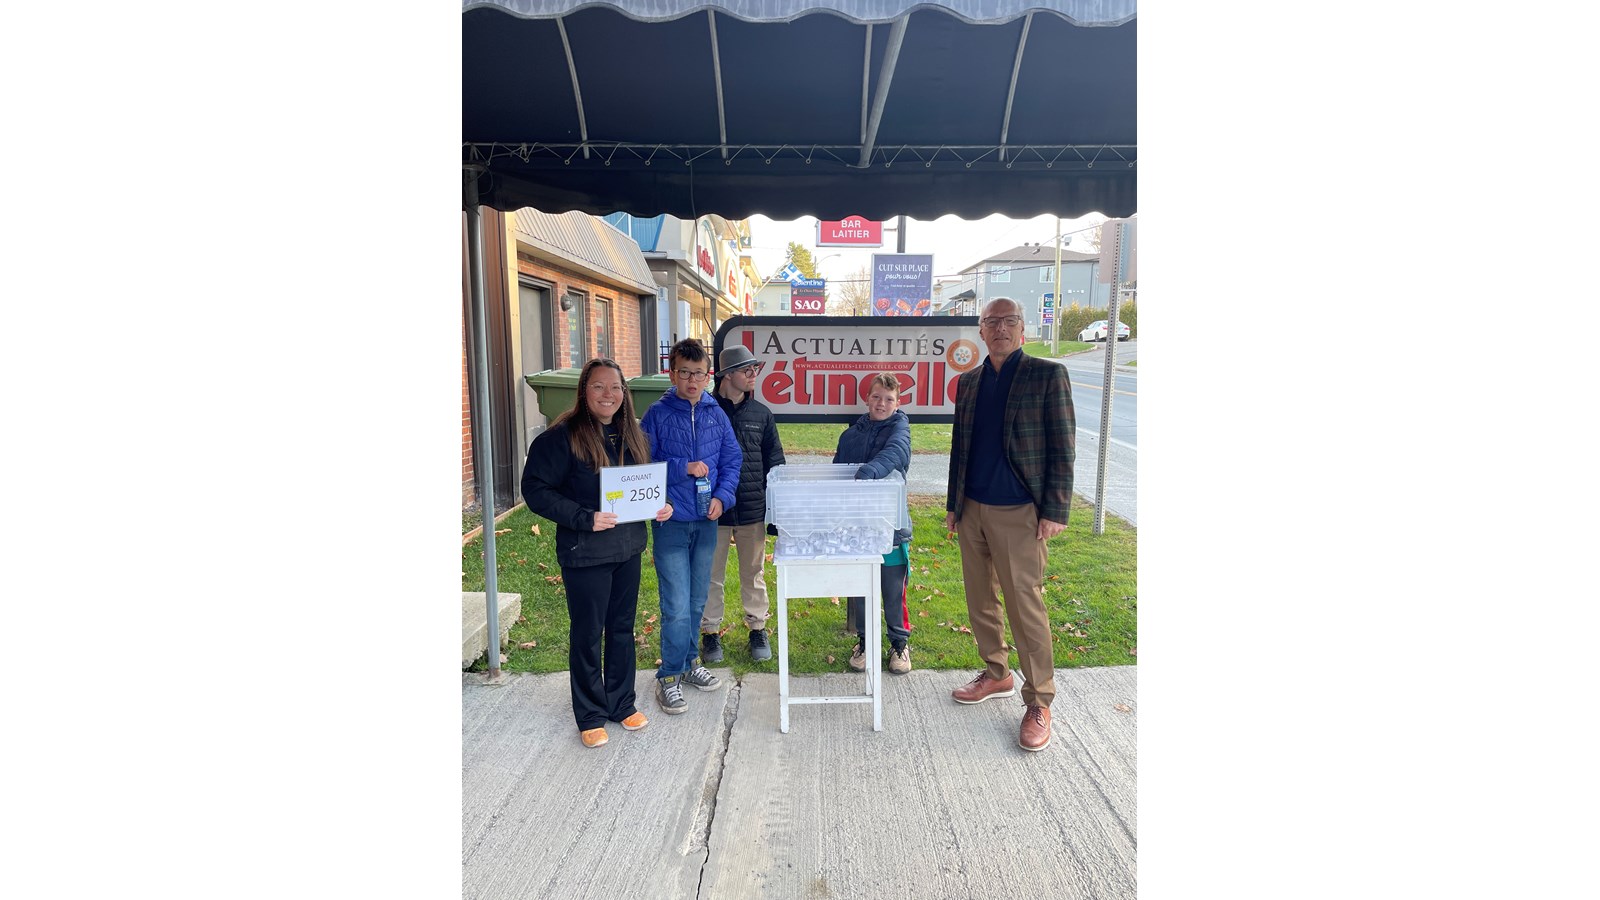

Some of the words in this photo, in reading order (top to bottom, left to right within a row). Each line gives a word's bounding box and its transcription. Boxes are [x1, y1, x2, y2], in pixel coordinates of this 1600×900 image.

[841, 220, 861, 228] BAR
[832, 230, 870, 238] LAITIER
[878, 264, 894, 272] CUIT
[895, 264, 907, 272] SUR
[908, 264, 929, 272] PLACE
[884, 273, 902, 281] pour
[794, 299, 822, 310] SAQ
[762, 331, 945, 356] ACTUALITÉS
[620, 473, 653, 483] GAGNANT
[630, 484, 661, 502] 250$
